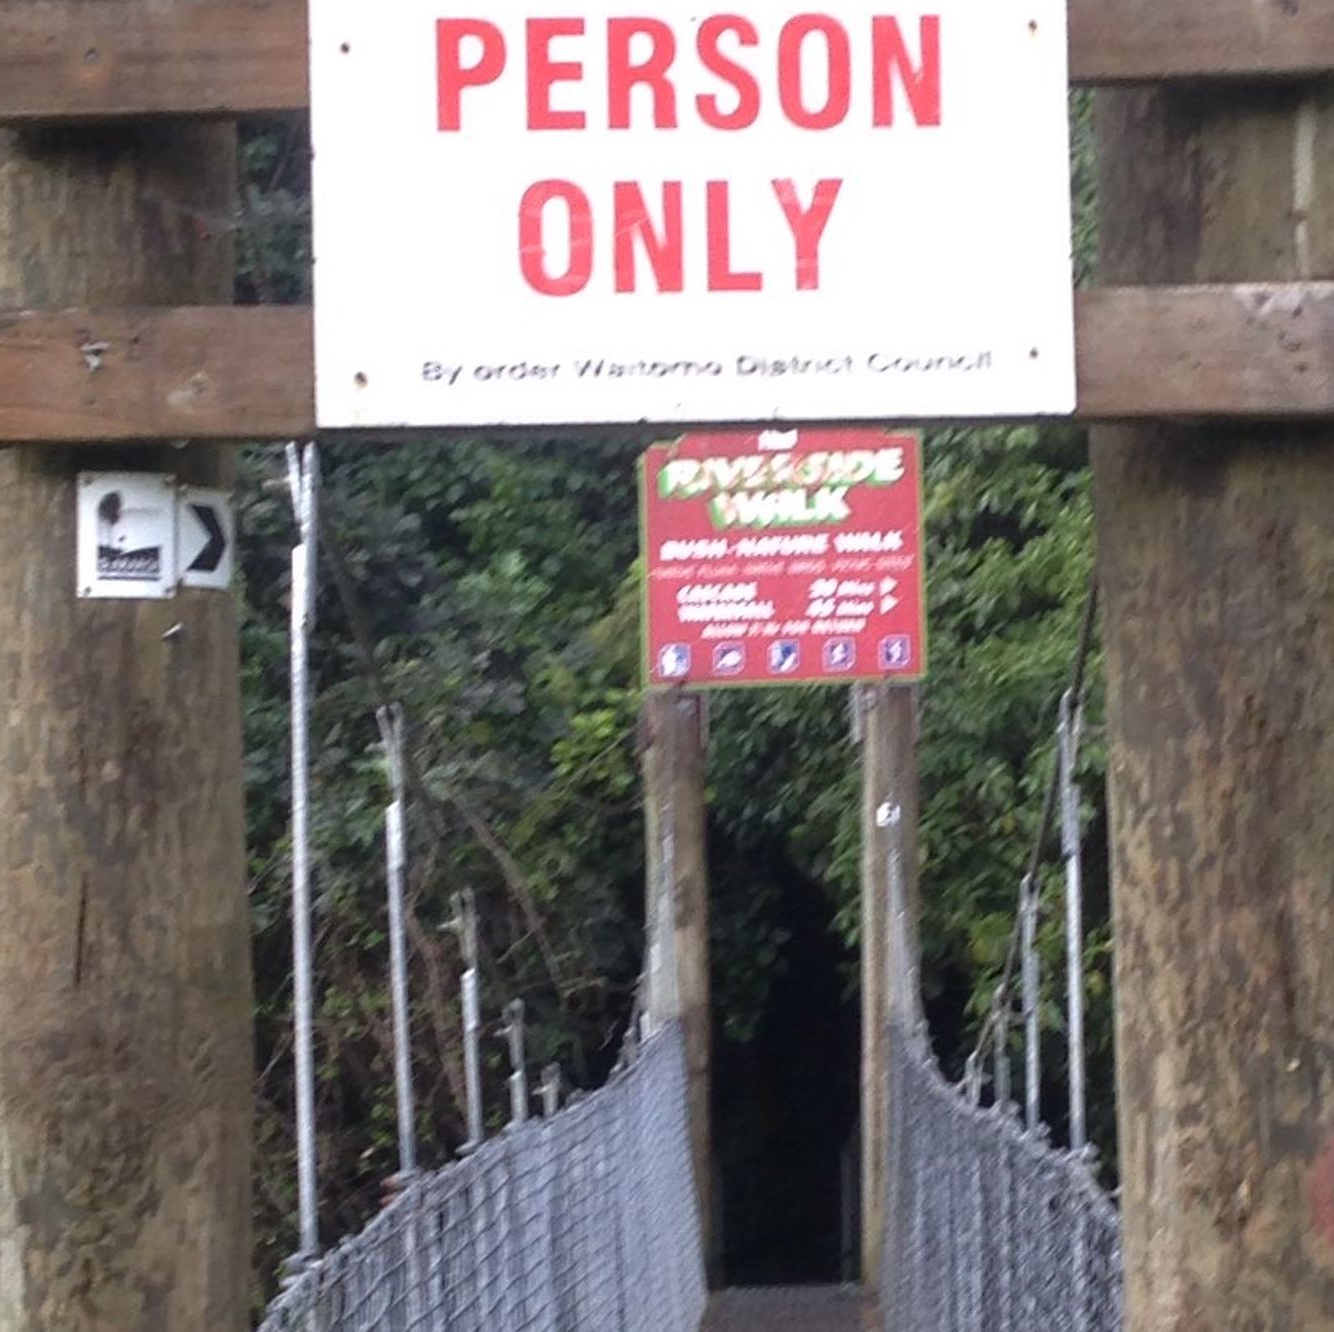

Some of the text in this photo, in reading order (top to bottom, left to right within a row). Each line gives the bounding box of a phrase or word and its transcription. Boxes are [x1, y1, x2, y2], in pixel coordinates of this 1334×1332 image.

[435, 13, 941, 132] PERSON
[518, 178, 843, 297] ONLY
[421, 360, 463, 385] By
[473, 361, 560, 381] order
[736, 354, 854, 377] District
[866, 350, 992, 373] Council
